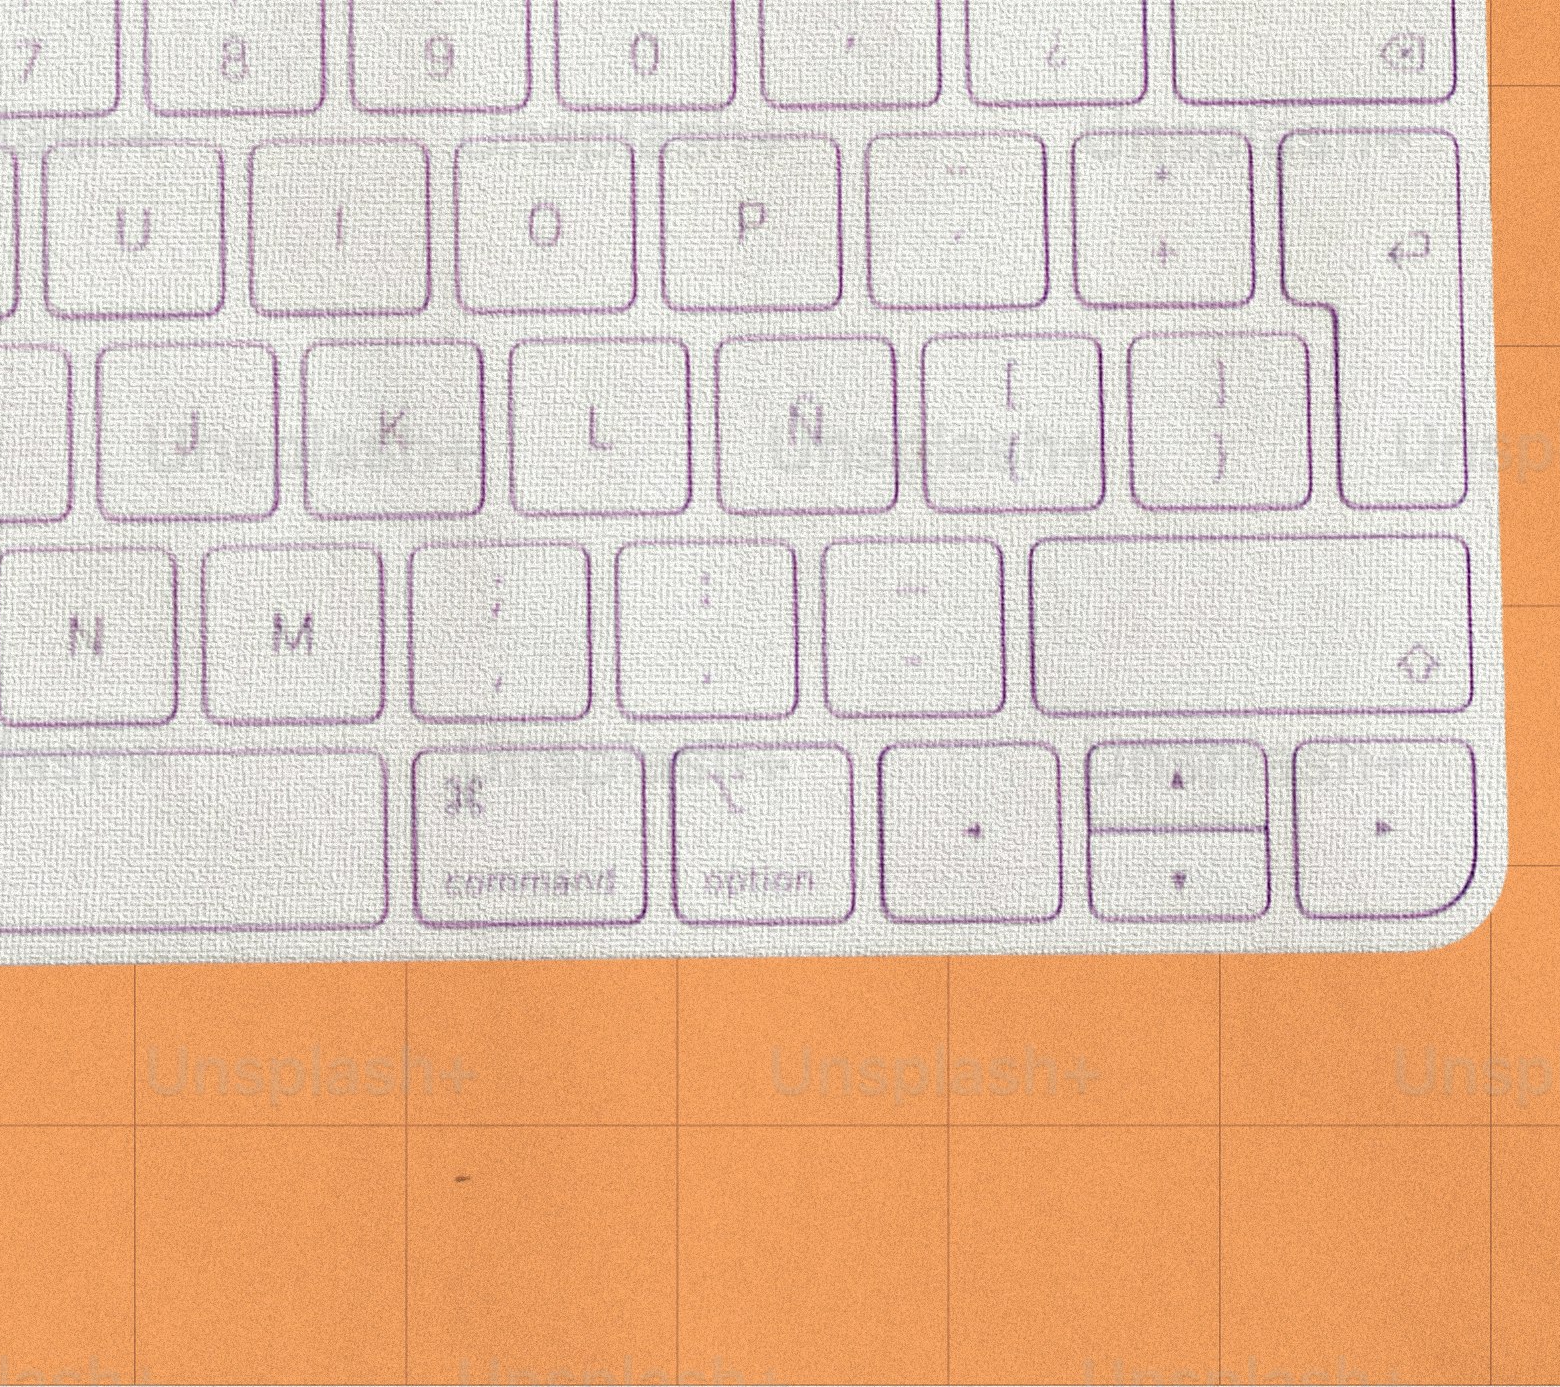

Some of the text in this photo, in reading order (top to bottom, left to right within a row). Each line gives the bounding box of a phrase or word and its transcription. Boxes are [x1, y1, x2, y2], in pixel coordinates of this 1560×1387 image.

[16, 38, 45, 83] 7
[217, 35, 250, 83] 8
[422, 33, 457, 81] 9
[627, 31, 664, 76] 0
[114, 207, 153, 253] U
[525, 200, 564, 249] O
[734, 199, 768, 243] P
[173, 409, 202, 457] J
[376, 407, 412, 451] K
[584, 405, 615, 451] L
[786, 393, 826, 447] Ñ
[66, 613, 106, 658] N
[271, 611, 316, 654] M
[442, 865, 616, 896] command
[704, 865, 817, 897] option
